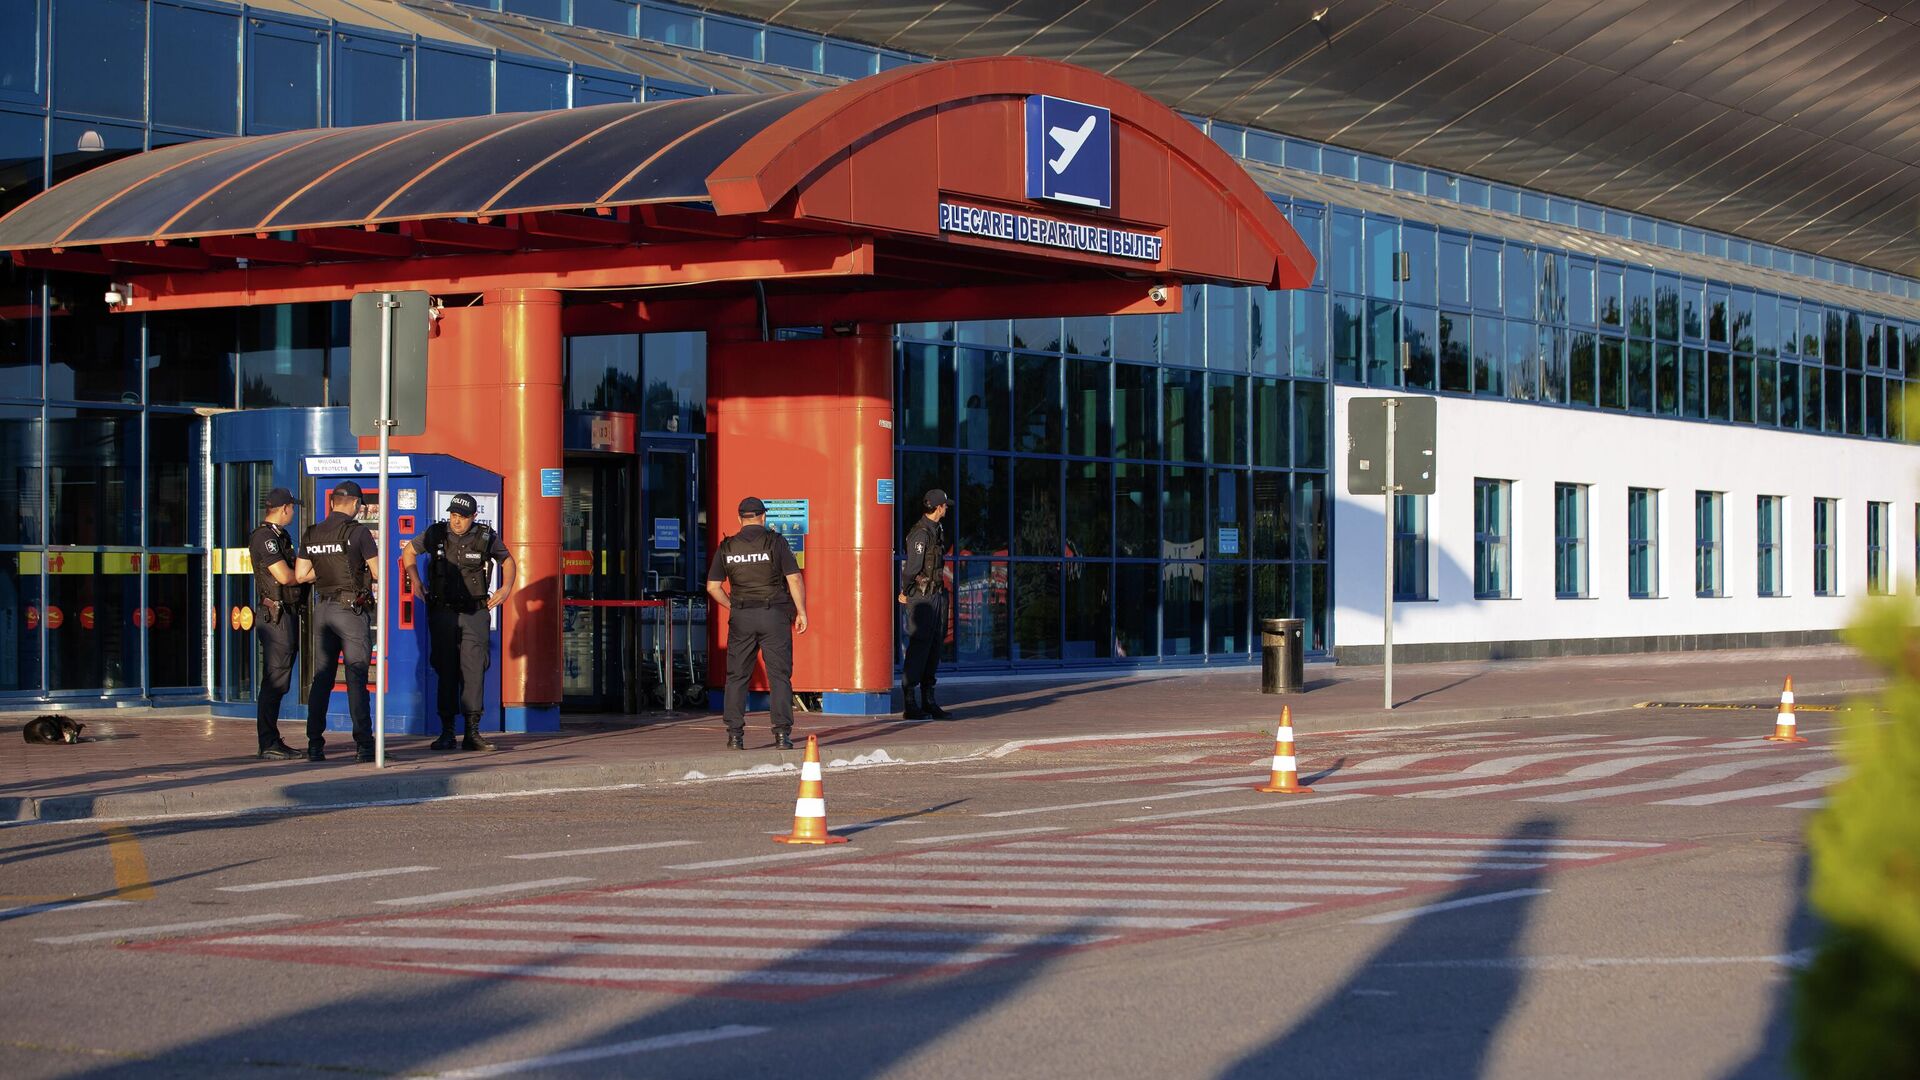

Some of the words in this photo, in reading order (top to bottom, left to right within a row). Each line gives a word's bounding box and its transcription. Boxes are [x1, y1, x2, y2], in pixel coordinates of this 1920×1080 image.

[939, 203, 1014, 239] PLECARE
[1018, 215, 1109, 252] DEPARTURE
[1112, 230, 1162, 260] ВЫЛЕТ
